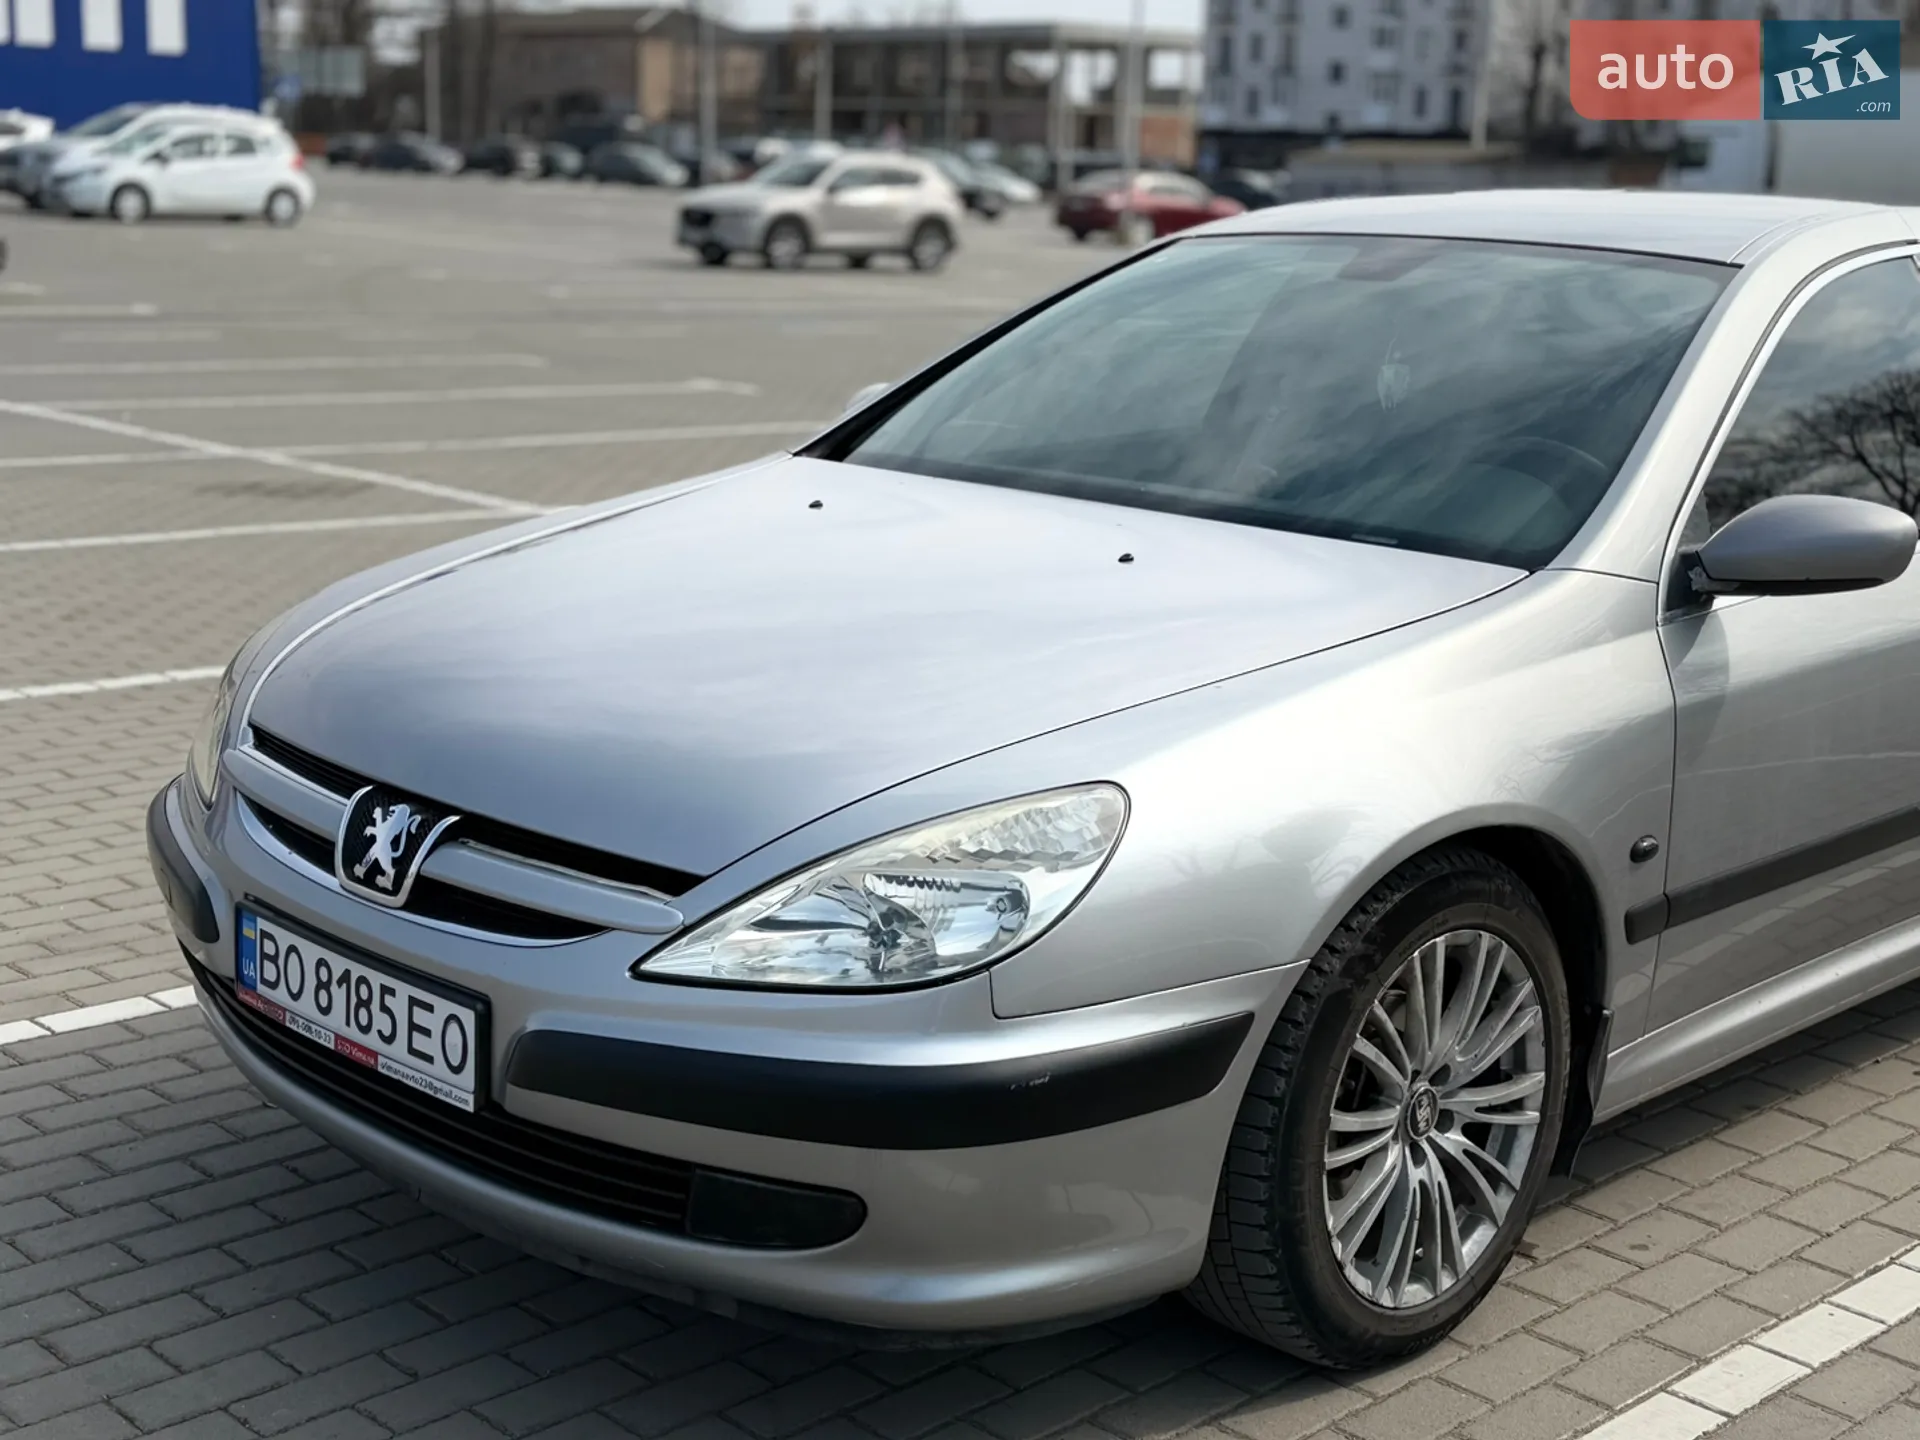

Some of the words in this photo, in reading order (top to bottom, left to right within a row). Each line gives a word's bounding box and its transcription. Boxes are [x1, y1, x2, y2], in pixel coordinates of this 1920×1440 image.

[241, 956, 256, 979] UA
[260, 928, 304, 1002] BO
[313, 957, 397, 1046] 8185
[407, 994, 469, 1075] EO
